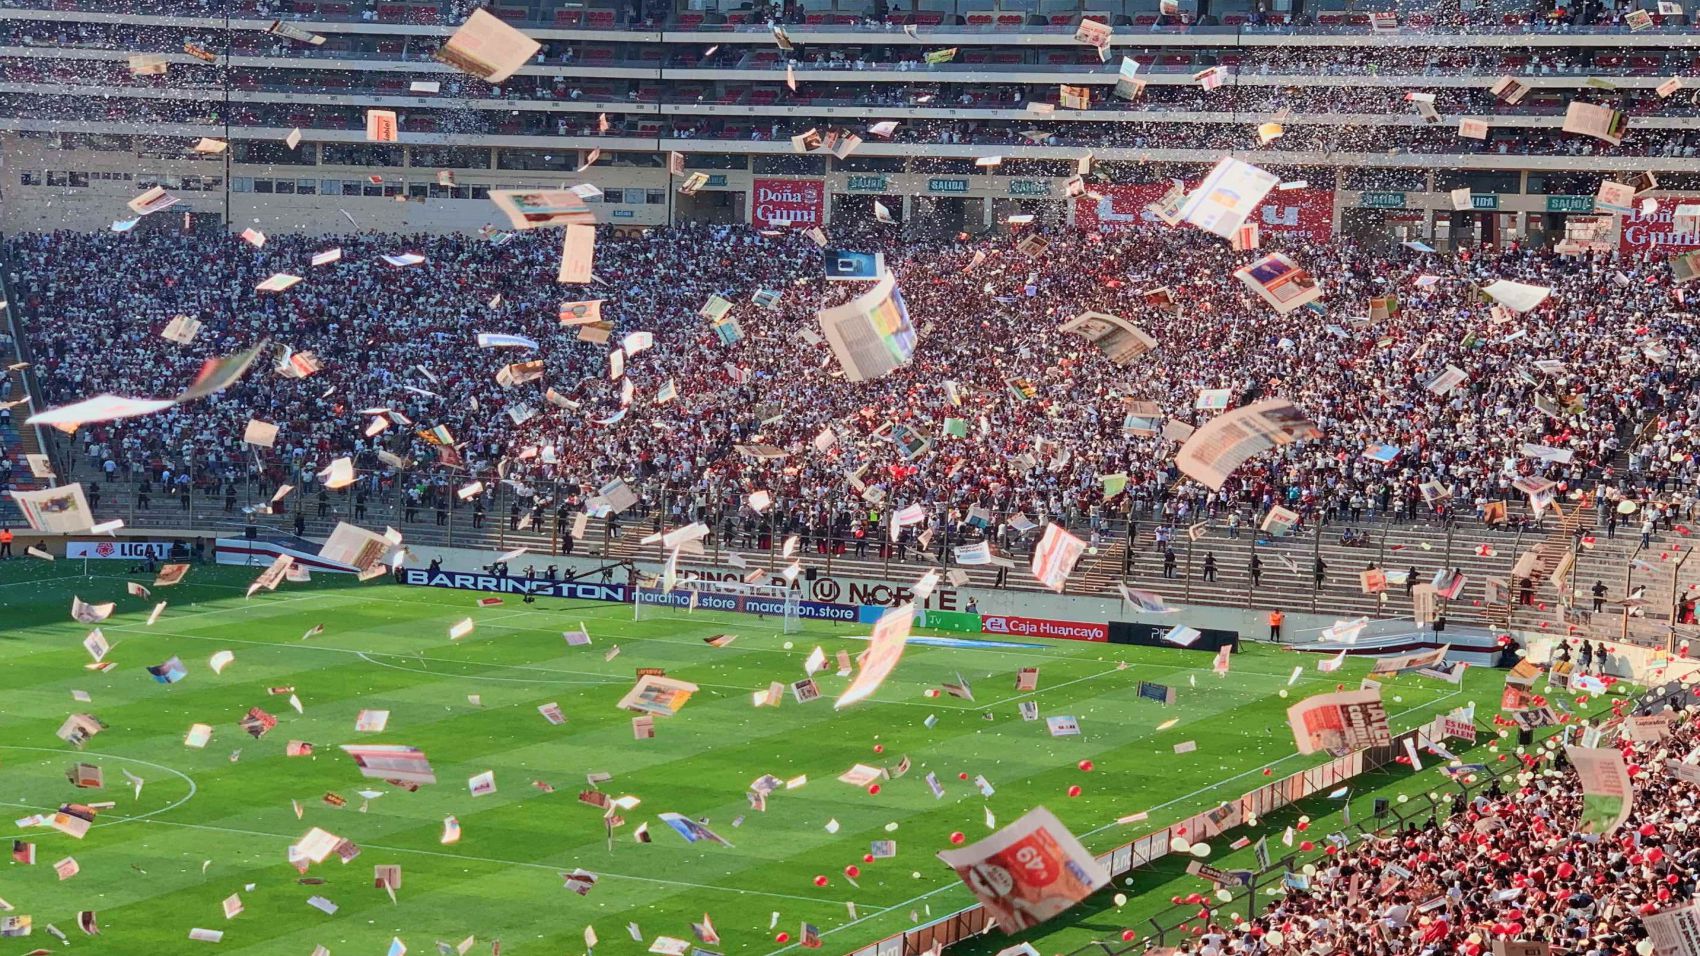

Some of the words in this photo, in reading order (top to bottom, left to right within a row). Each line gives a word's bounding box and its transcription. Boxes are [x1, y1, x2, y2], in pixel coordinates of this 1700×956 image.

[758, 185, 802, 203] Doña
[931, 180, 965, 190] SALIDA
[1471, 197, 1494, 207] LIDA
[1551, 198, 1589, 208] SALIDA
[756, 205, 816, 223] Gumi
[1629, 207, 1673, 223] Doñ
[406, 570, 624, 601] BARRINGTON
[631, 591, 736, 610] maratho.store
[746, 601, 854, 618] marahon.store
[1009, 620, 1037, 634] Caja
[1040, 622, 1104, 640] Huancayo
